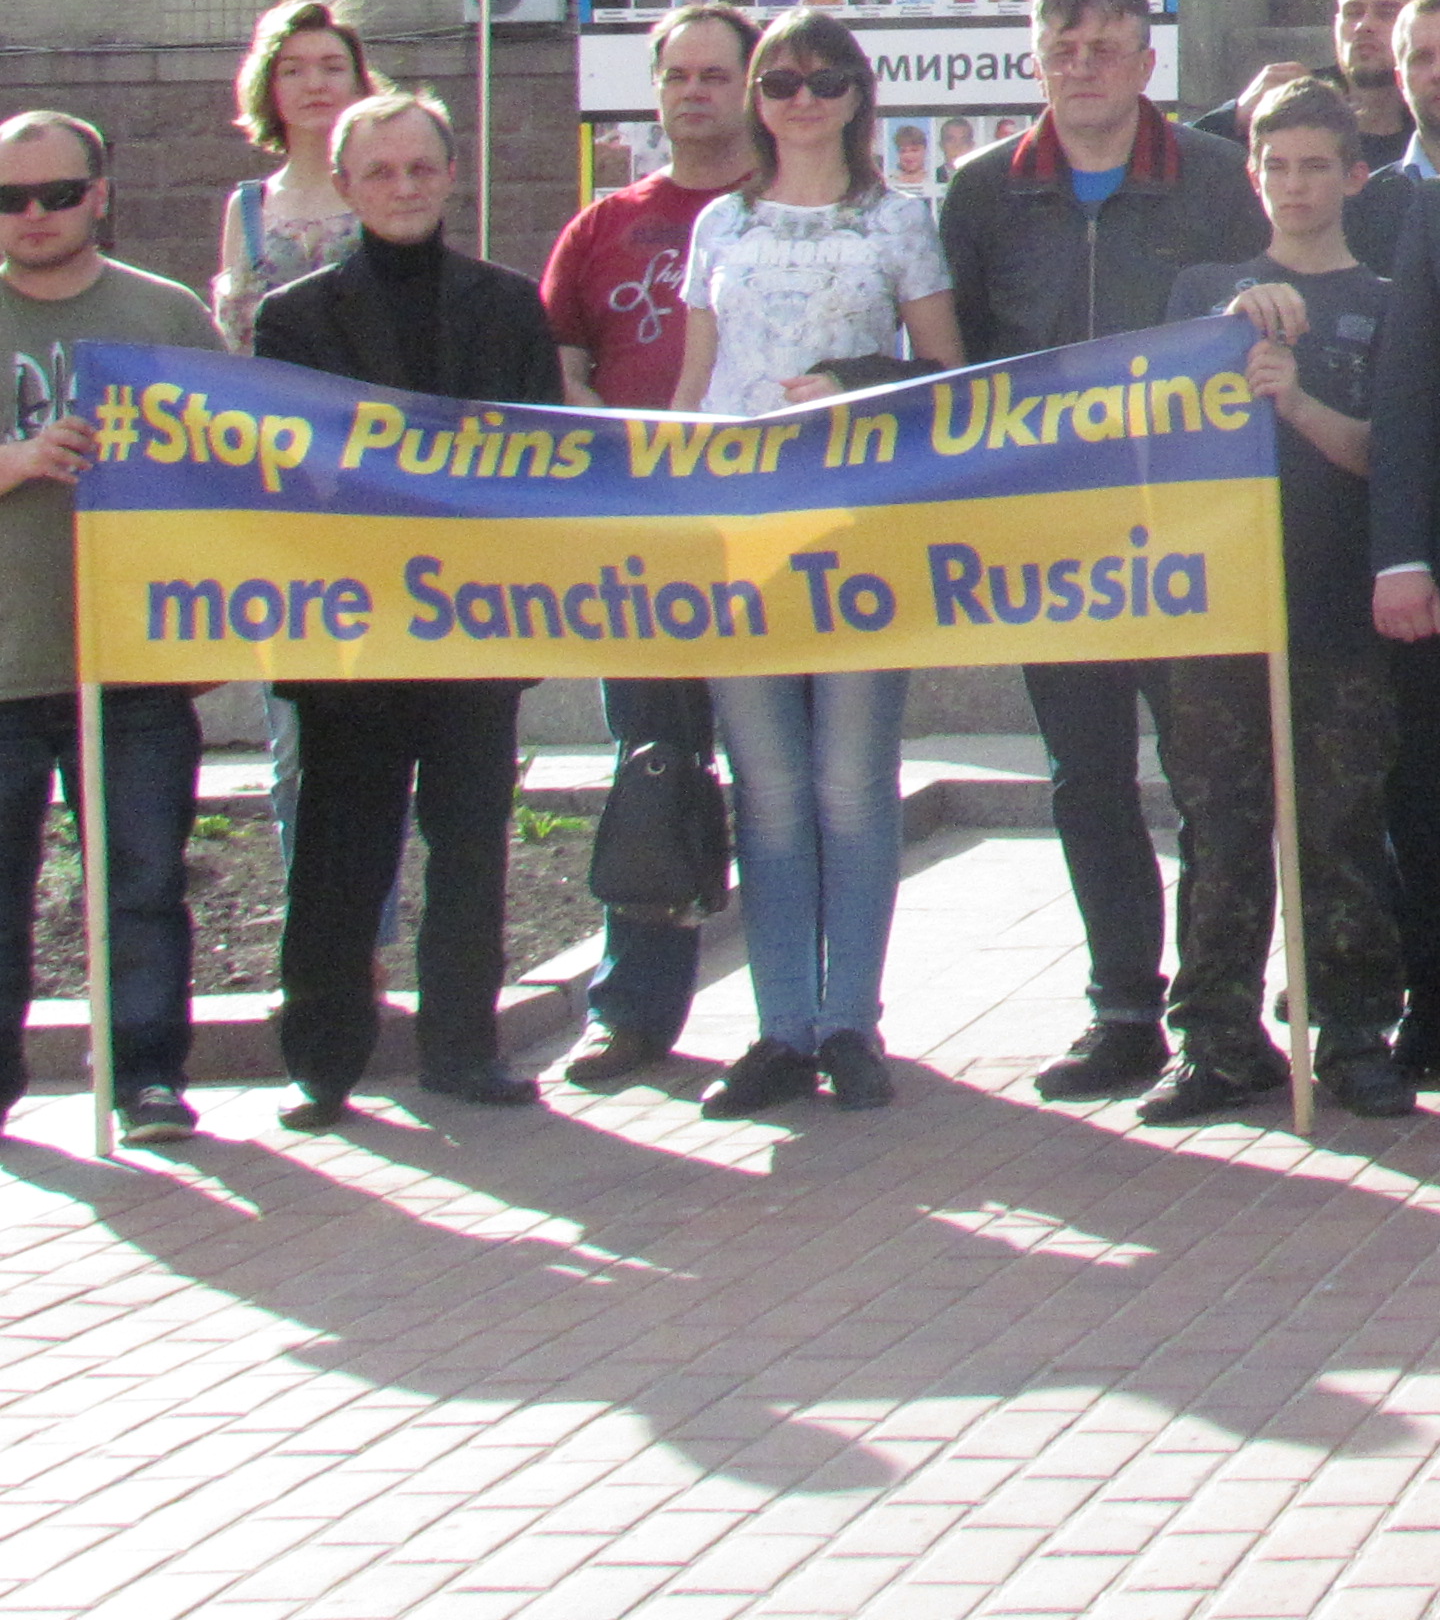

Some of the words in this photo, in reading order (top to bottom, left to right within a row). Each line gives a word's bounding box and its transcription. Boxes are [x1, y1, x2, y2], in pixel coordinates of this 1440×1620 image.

[95, 381, 313, 493] #Stop
[340, 401, 595, 479] Putins
[624, 418, 799, 479] War
[823, 404, 897, 468] In
[930, 355, 1254, 457] Ukraine
[146, 577, 374, 642] more
[403, 555, 768, 642] Sanction
[790, 549, 896, 634] To
[926, 525, 1208, 628] Russia
